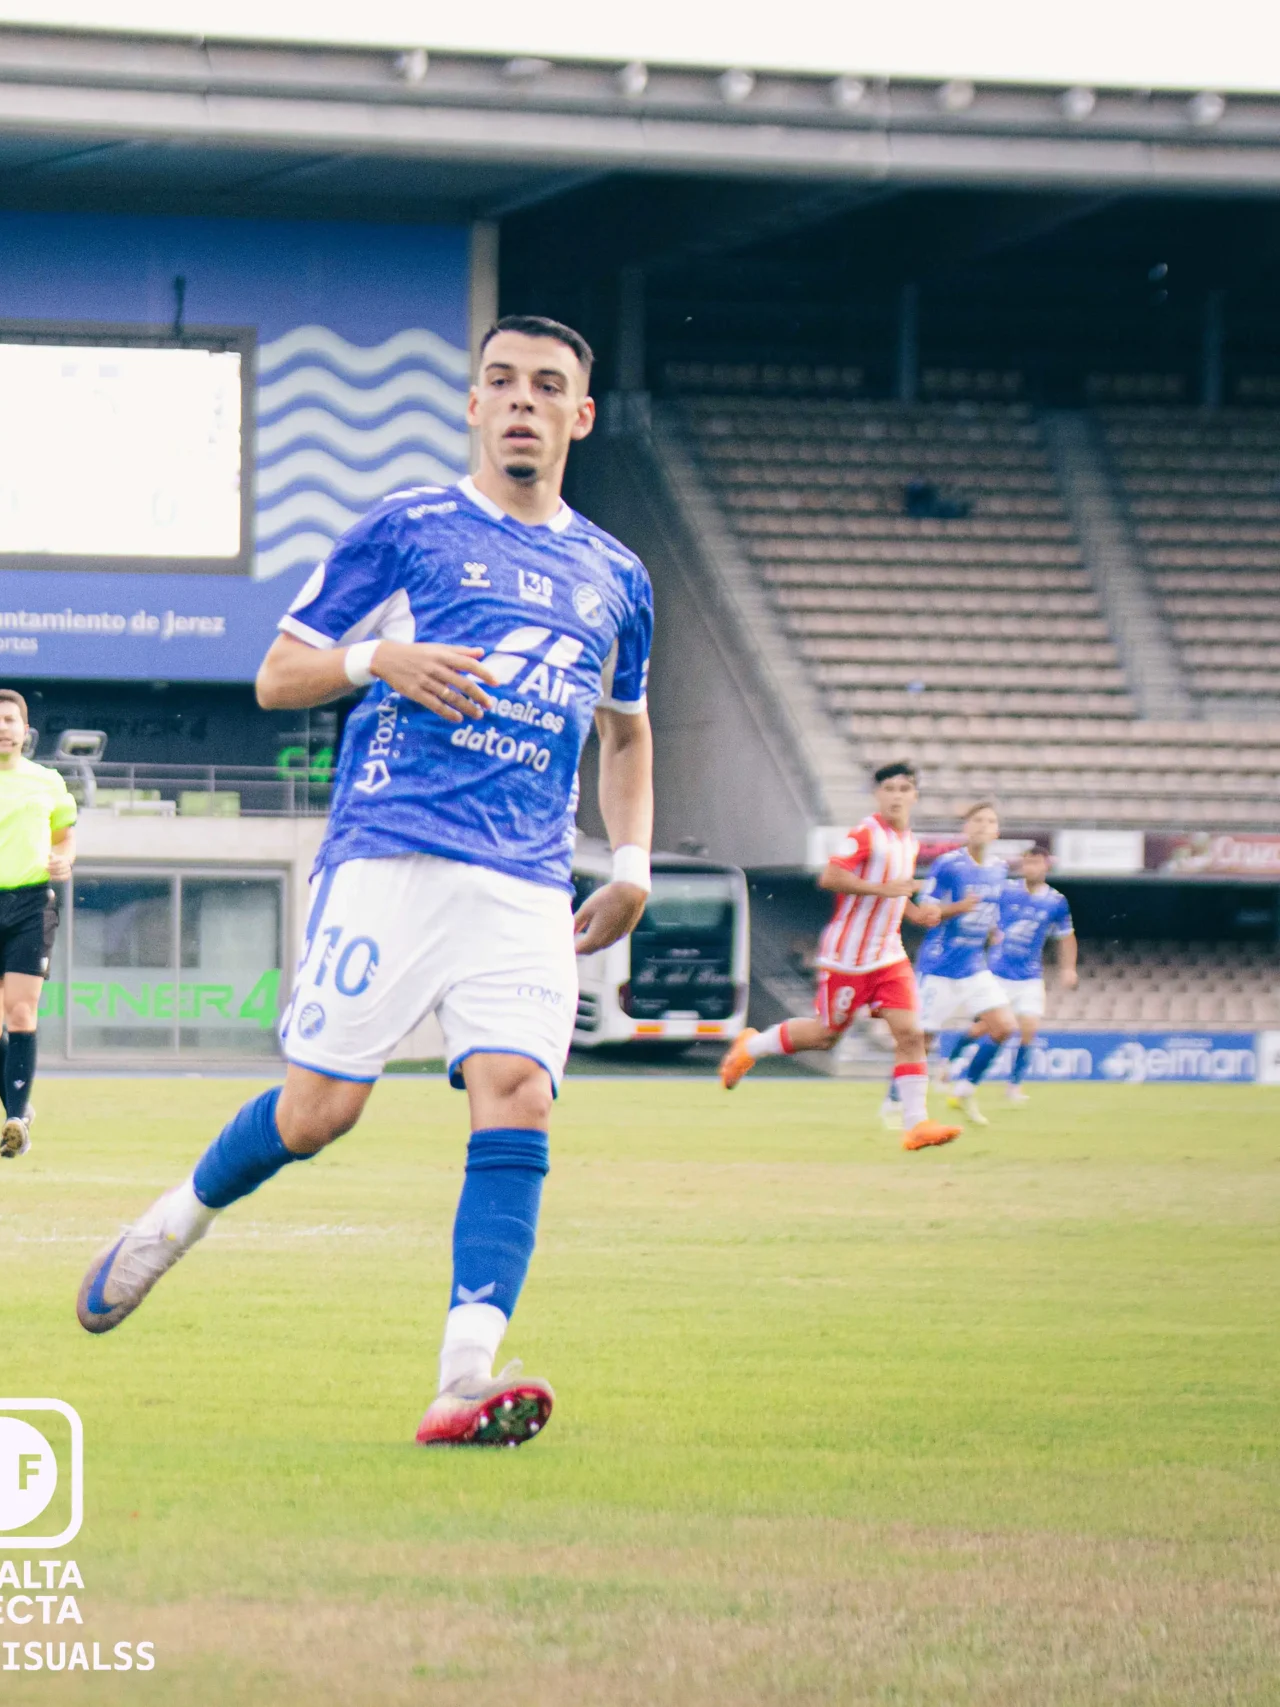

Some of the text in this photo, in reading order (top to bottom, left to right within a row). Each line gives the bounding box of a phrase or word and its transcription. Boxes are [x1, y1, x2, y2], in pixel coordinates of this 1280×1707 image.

[130, 609, 161, 636] de
[161, 609, 226, 641] Jerez
[516, 662, 577, 707] Air
[451, 724, 551, 773] datono
[313, 925, 380, 997] 10
